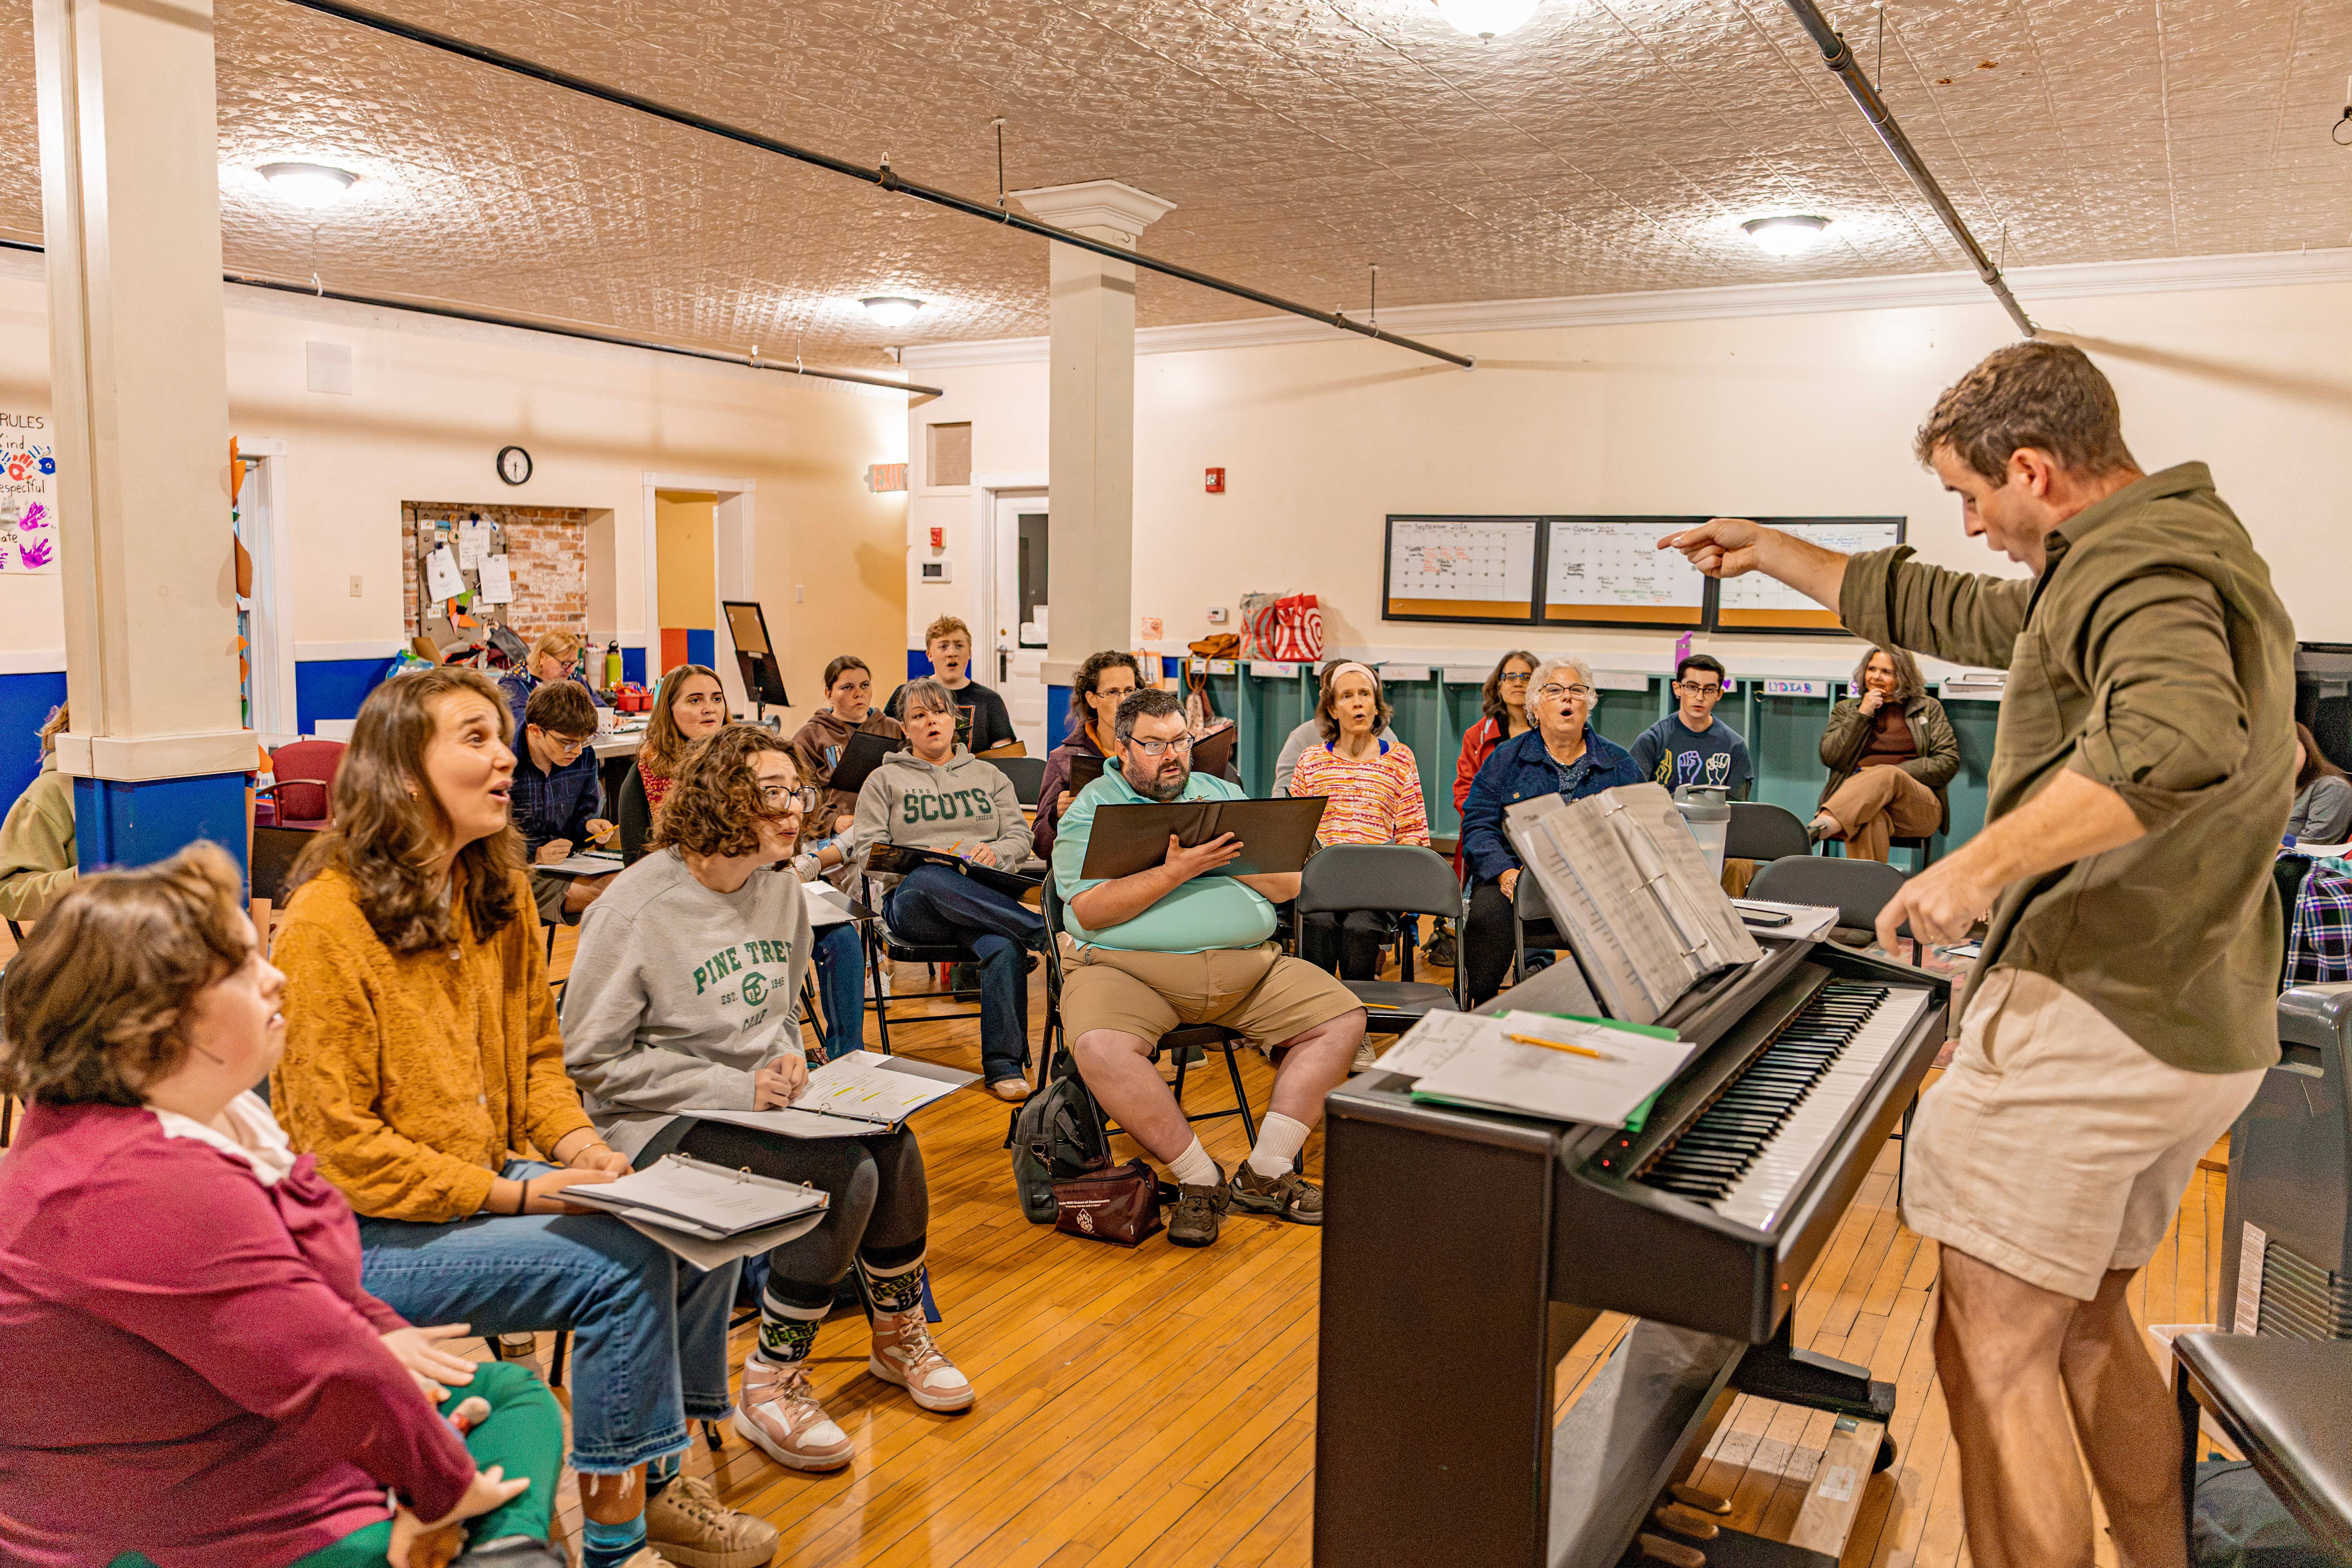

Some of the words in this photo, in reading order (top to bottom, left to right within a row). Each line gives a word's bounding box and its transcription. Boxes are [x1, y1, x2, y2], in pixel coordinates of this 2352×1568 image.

[0, 414, 44, 428] RULES
[873, 463, 902, 491] EXIT
[903, 788, 992, 824] SCOTS
[693, 947, 742, 996] PINE
